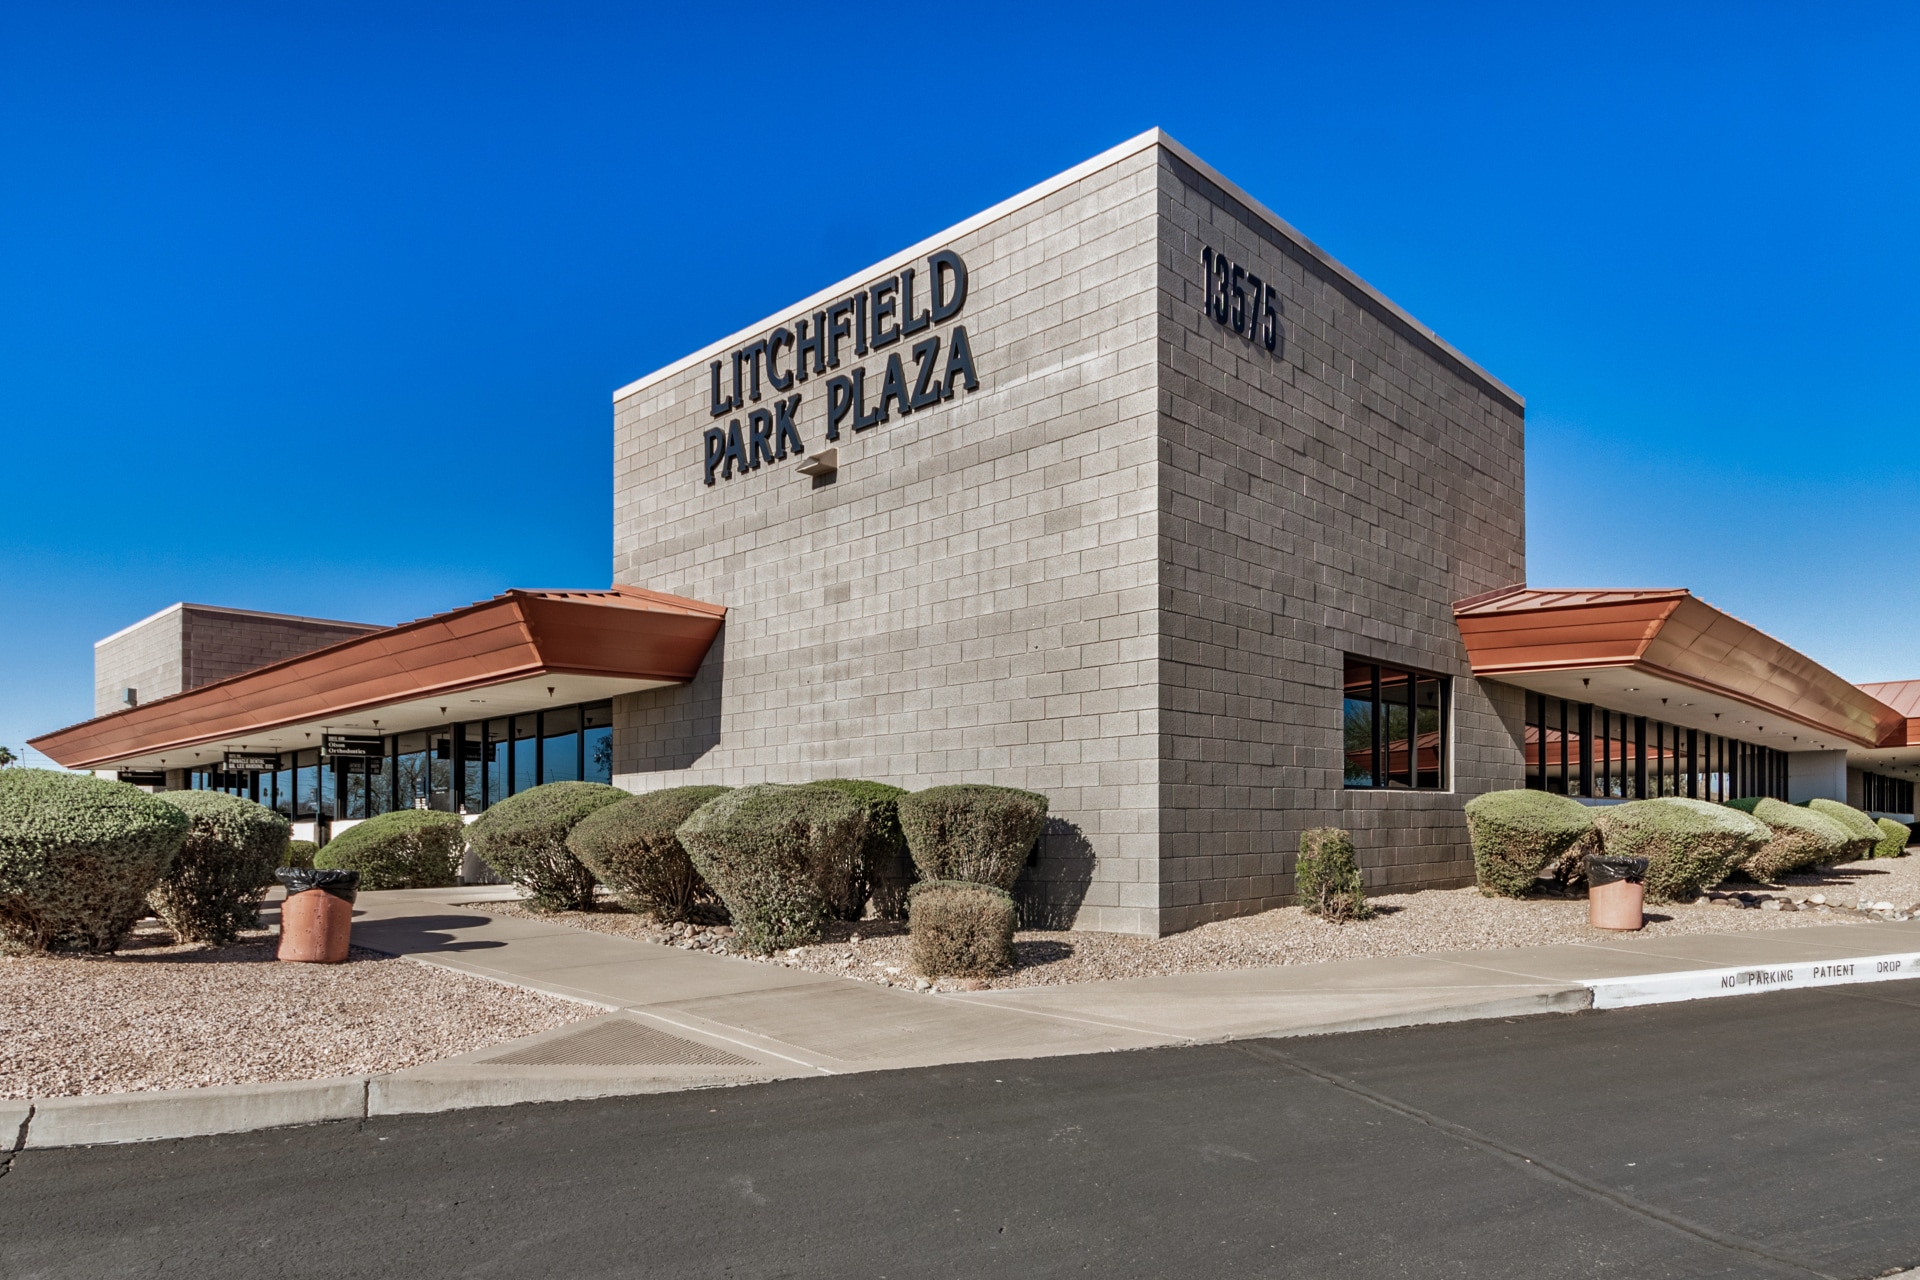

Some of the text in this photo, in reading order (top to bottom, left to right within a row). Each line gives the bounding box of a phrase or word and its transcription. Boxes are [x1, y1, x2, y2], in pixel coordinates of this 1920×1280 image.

[710, 249, 968, 418] LITCHFIELD
[1200, 245, 1277, 352] 13575
[703, 325, 980, 486] PARK PLAZA
[1721, 960, 1901, 988] NO PARKING PATIENT DROP
